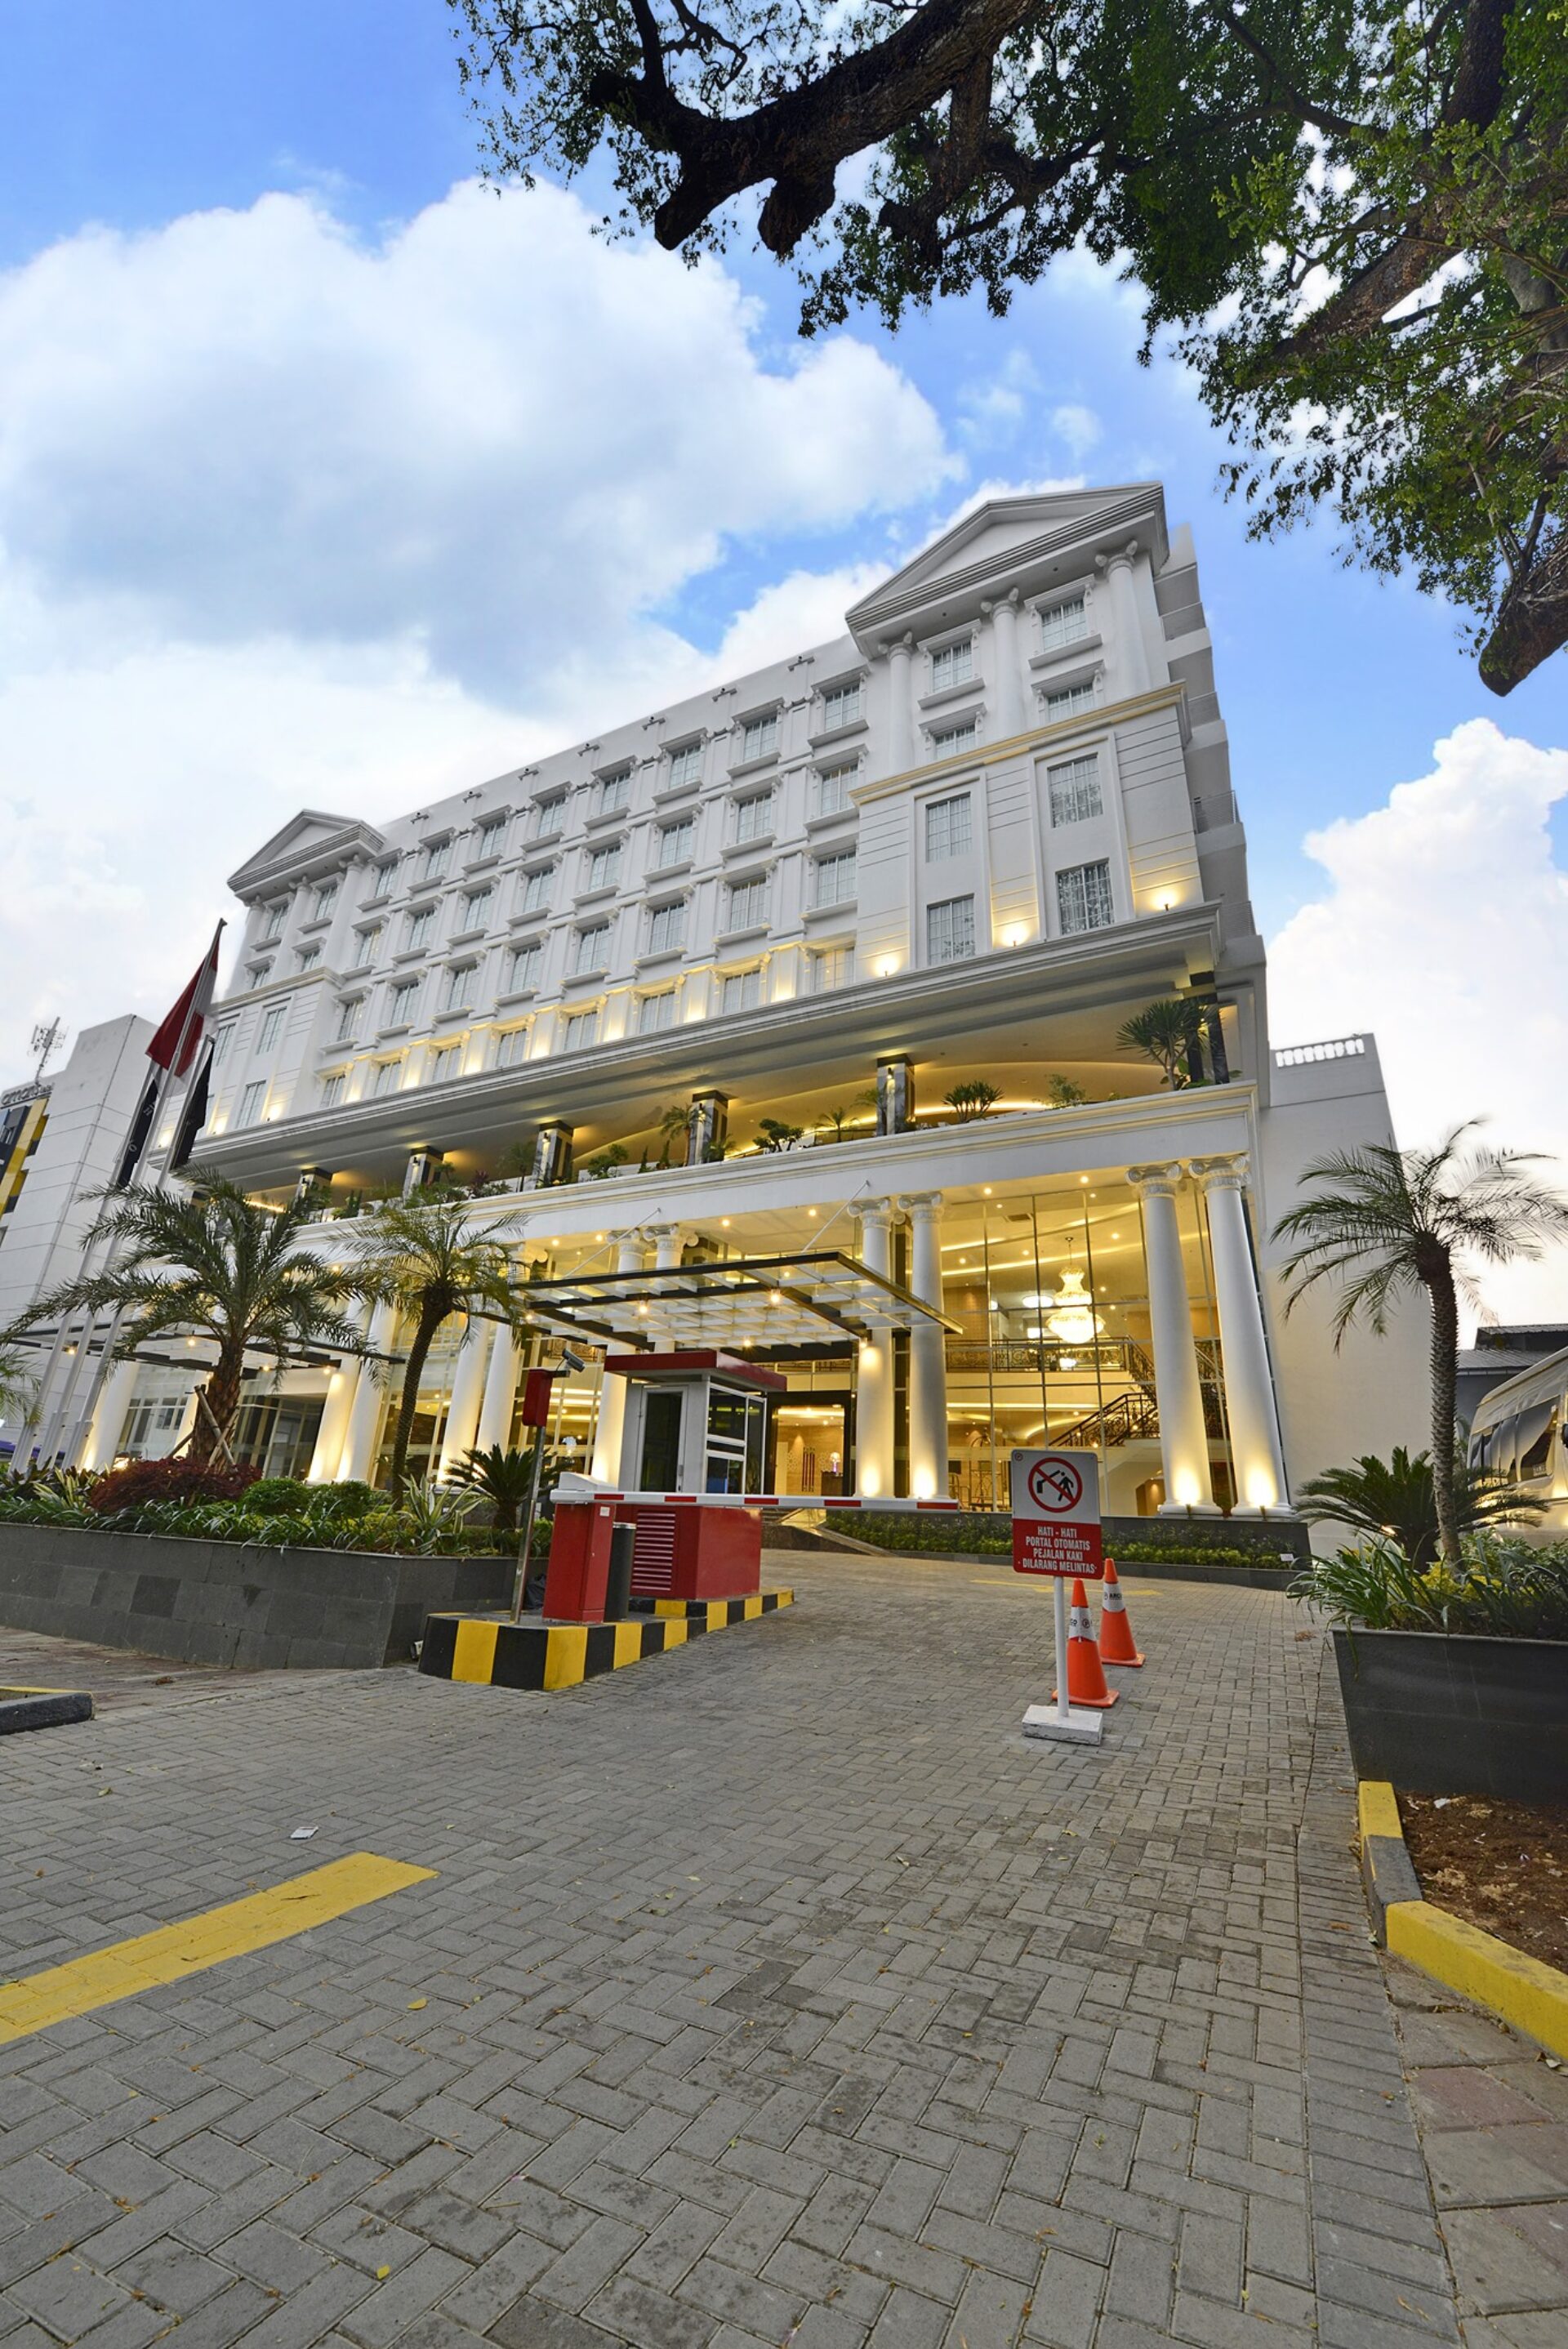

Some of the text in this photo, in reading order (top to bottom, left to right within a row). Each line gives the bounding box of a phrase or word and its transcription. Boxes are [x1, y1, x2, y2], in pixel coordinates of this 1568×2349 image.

[1037, 1526, 1054, 1536] HATI
[1061, 1527, 1077, 1538] HATI
[1026, 1536, 1091, 1550] PORTAL OTOMATIS
[1033, 1548, 1083, 1562] PEJALAN KAKI
[1022, 1558, 1095, 1574] DILARANG MELINTAS
